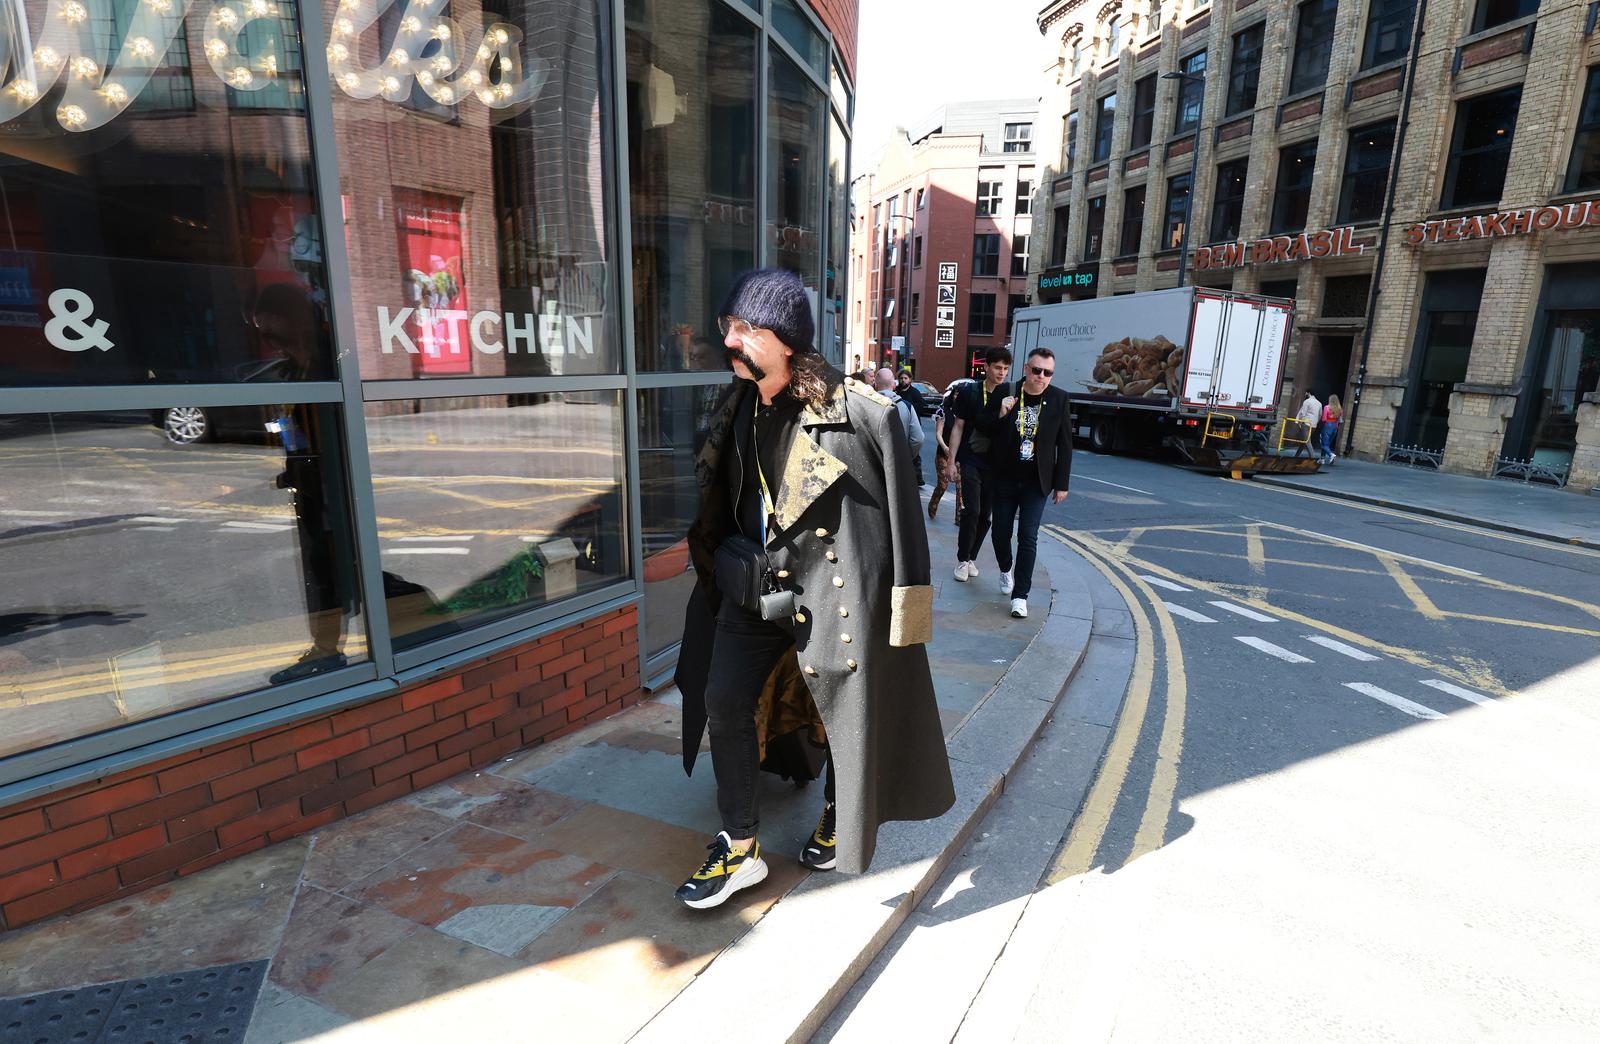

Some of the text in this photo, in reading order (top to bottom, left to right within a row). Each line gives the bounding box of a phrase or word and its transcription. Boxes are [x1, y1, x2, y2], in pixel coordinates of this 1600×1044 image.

[1194, 226, 1364, 271] BEM BRASIL
[941, 265, 955, 280] 福
[1040, 273, 1061, 288] level
[1075, 272, 1093, 287] tap
[44, 288, 595, 355] & KITCHEN
